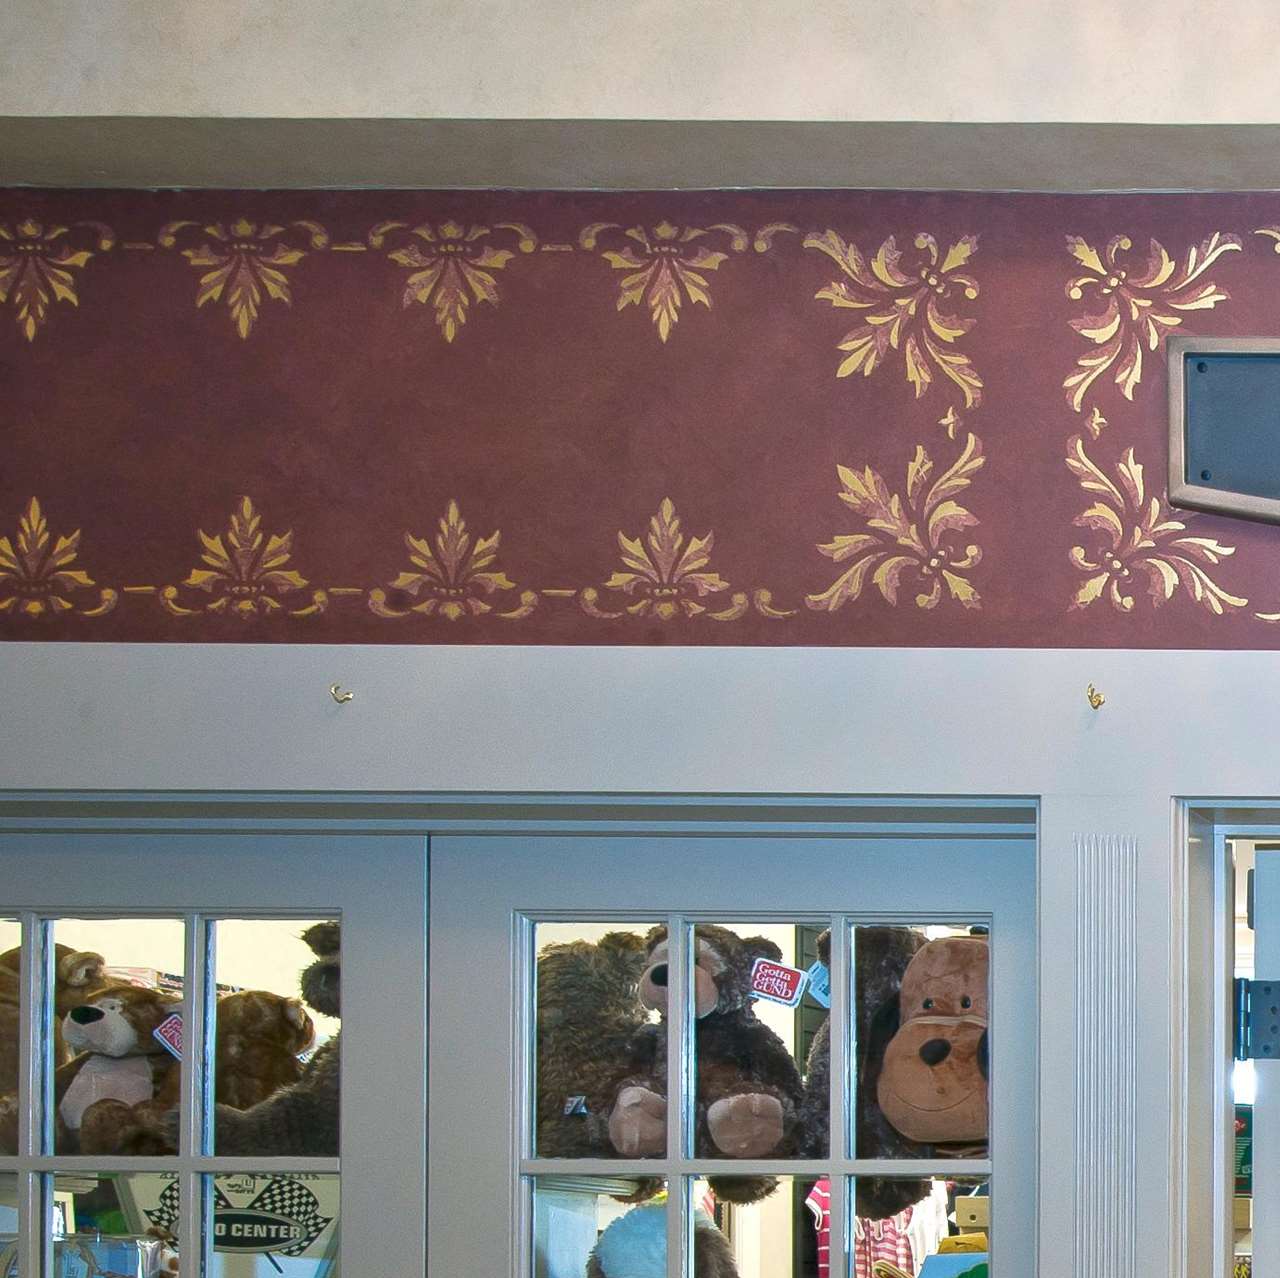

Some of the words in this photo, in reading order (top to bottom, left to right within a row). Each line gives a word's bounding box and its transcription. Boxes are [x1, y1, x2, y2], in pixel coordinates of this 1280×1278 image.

[759, 963, 792, 981] Gotta
[753, 980, 792, 998] GUND
[231, 1223, 300, 1239] CENTER
